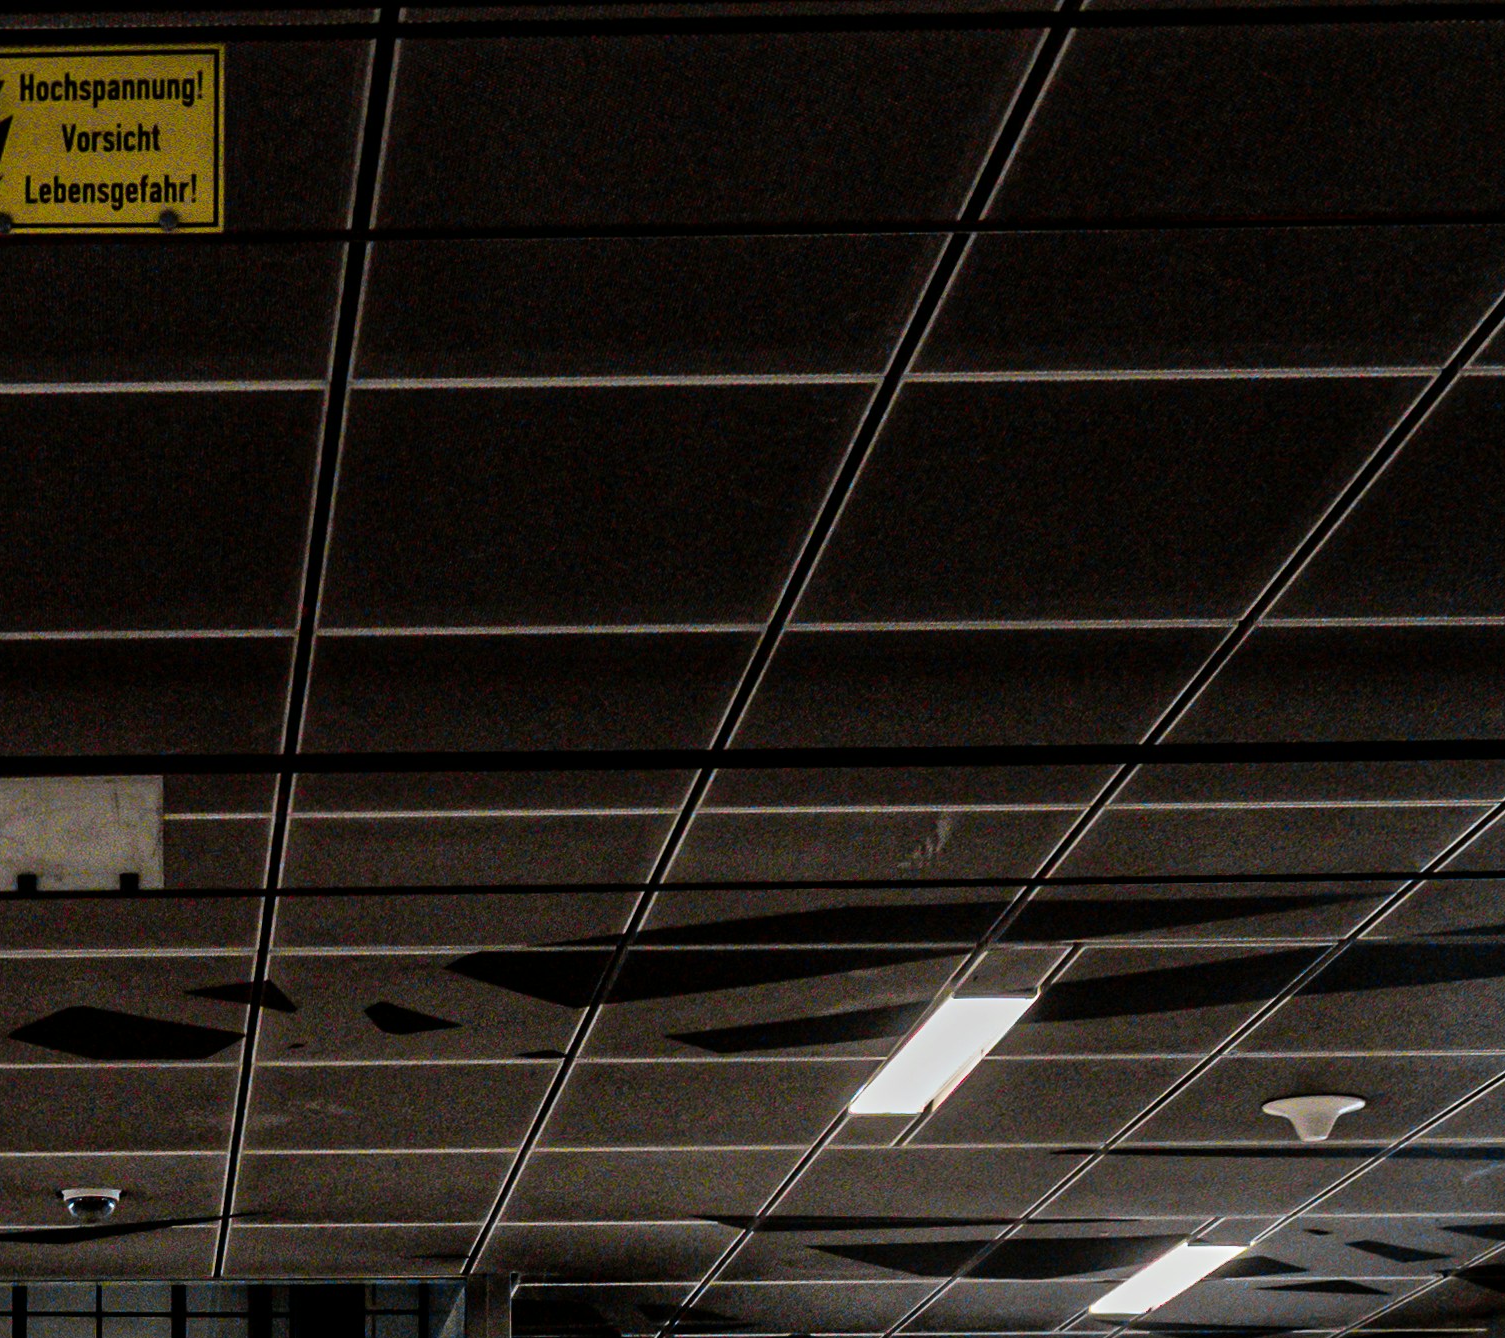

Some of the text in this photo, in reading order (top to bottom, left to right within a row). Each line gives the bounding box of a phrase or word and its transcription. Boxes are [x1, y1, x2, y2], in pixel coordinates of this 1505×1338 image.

[19, 71, 204, 108] Hochspannung!
[62, 123, 161, 152] Vorsicht
[24, 174, 198, 211] Lebensgefahr!
